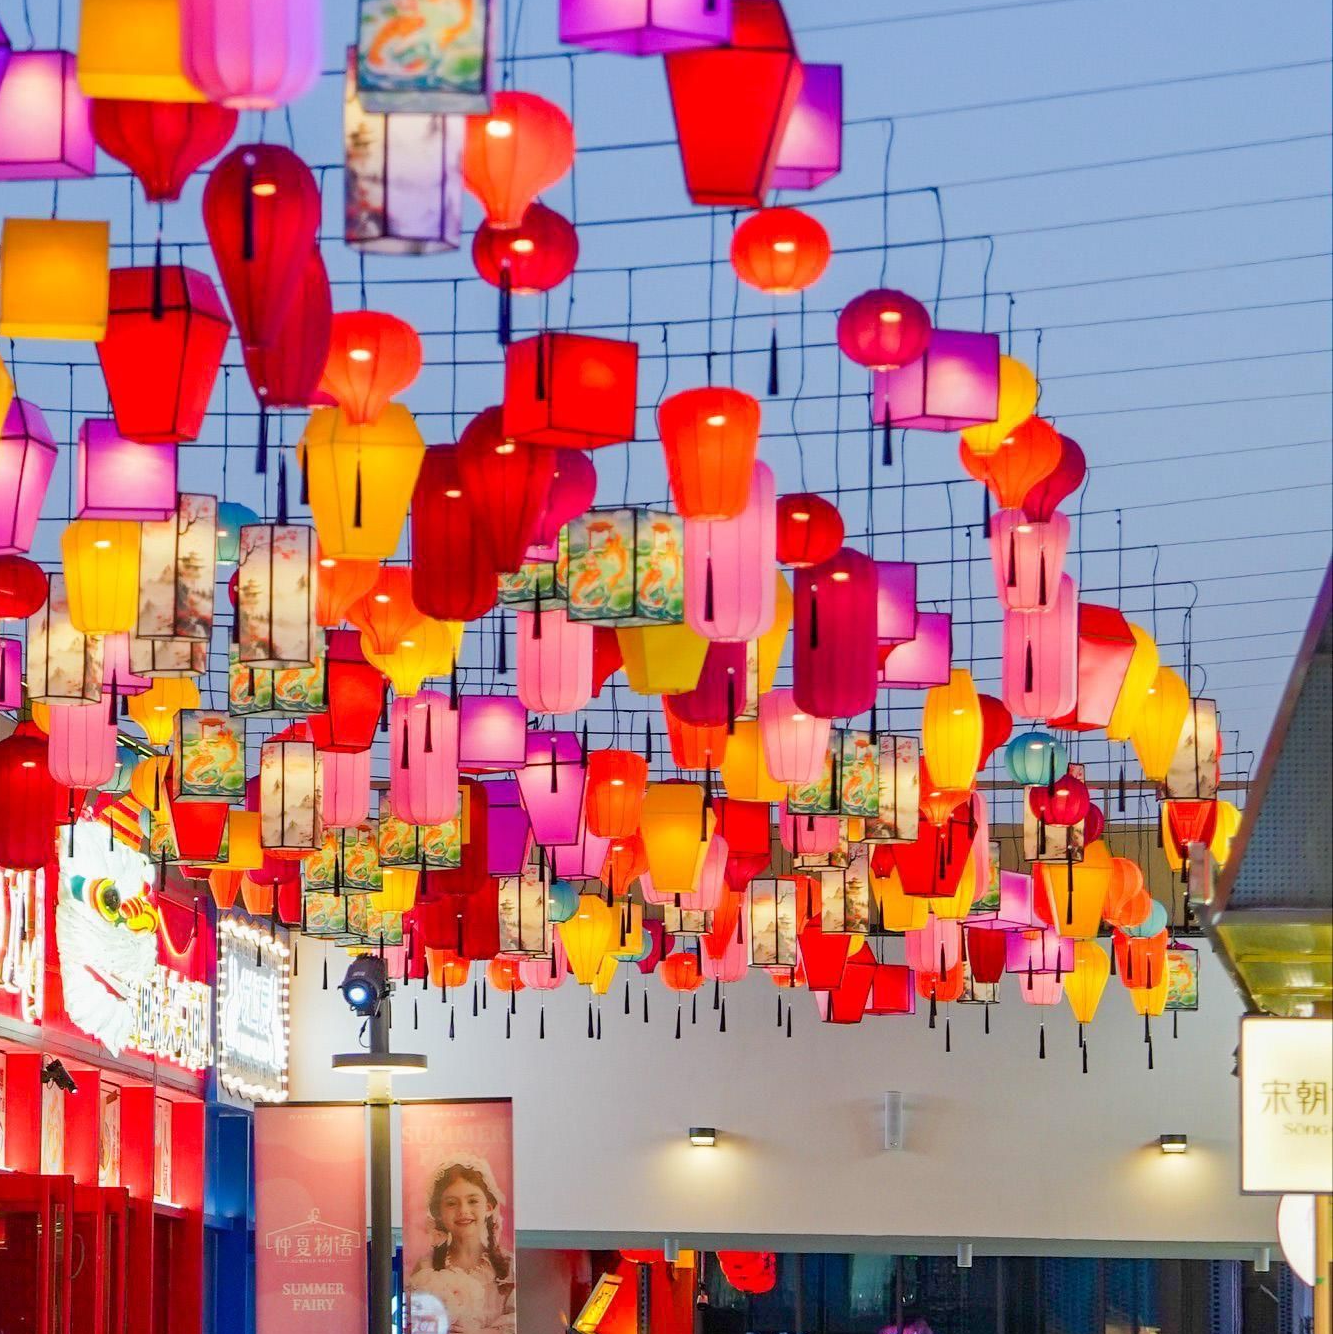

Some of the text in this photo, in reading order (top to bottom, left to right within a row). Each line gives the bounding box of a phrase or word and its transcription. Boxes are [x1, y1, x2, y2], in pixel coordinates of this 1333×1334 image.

[1259, 1080, 1327, 1116] 宋朝
[274, 1234, 353, 1257] 仲夏物语
[282, 1282, 345, 1296] SUMMER
[293, 1298, 335, 1312] FAIRY
